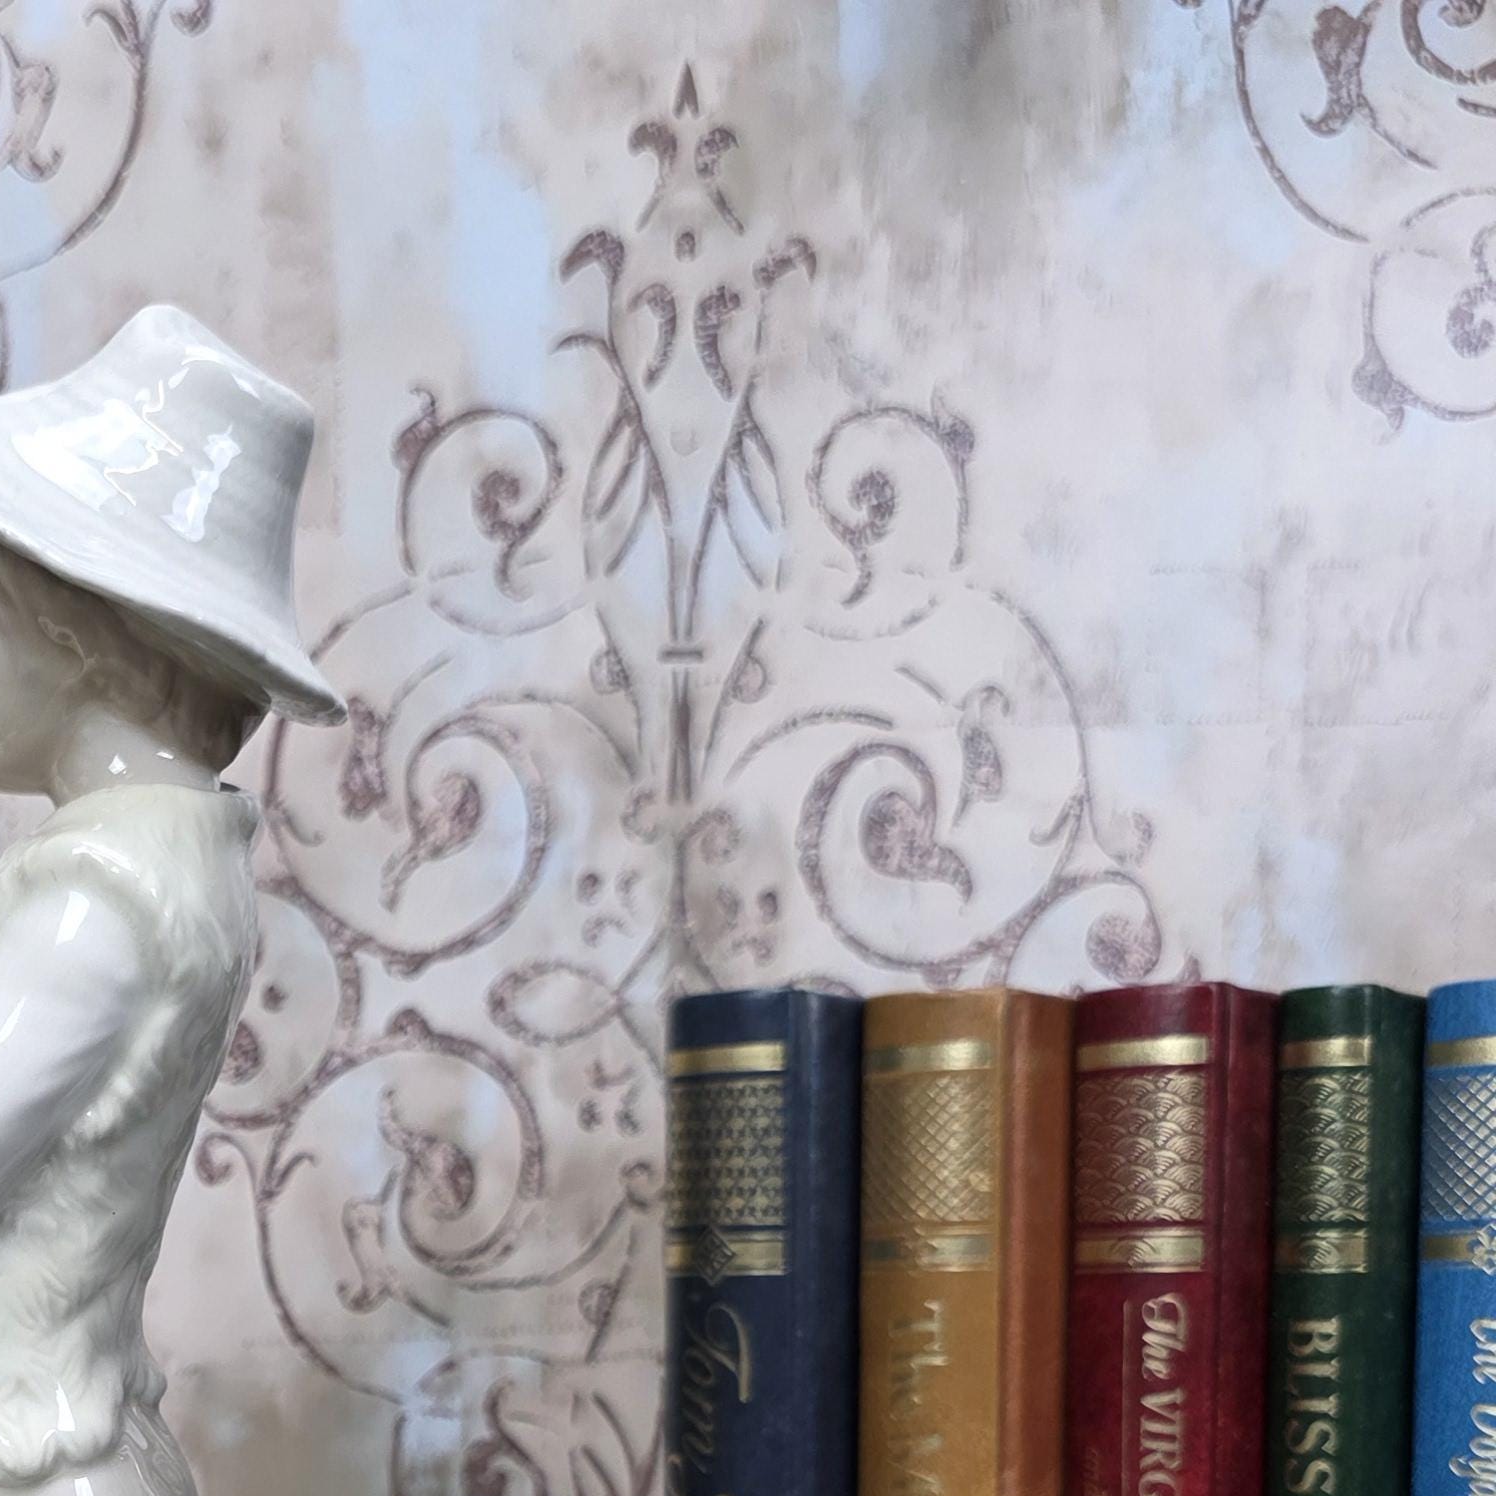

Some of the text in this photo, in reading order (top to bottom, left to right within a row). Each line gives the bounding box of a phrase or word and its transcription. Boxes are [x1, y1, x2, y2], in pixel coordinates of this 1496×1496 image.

[680, 1303, 752, 1474] Tom
[889, 1299, 950, 1422] The
[1141, 1292, 1188, 1381] The
[1283, 1313, 1341, 1496] BLISS
